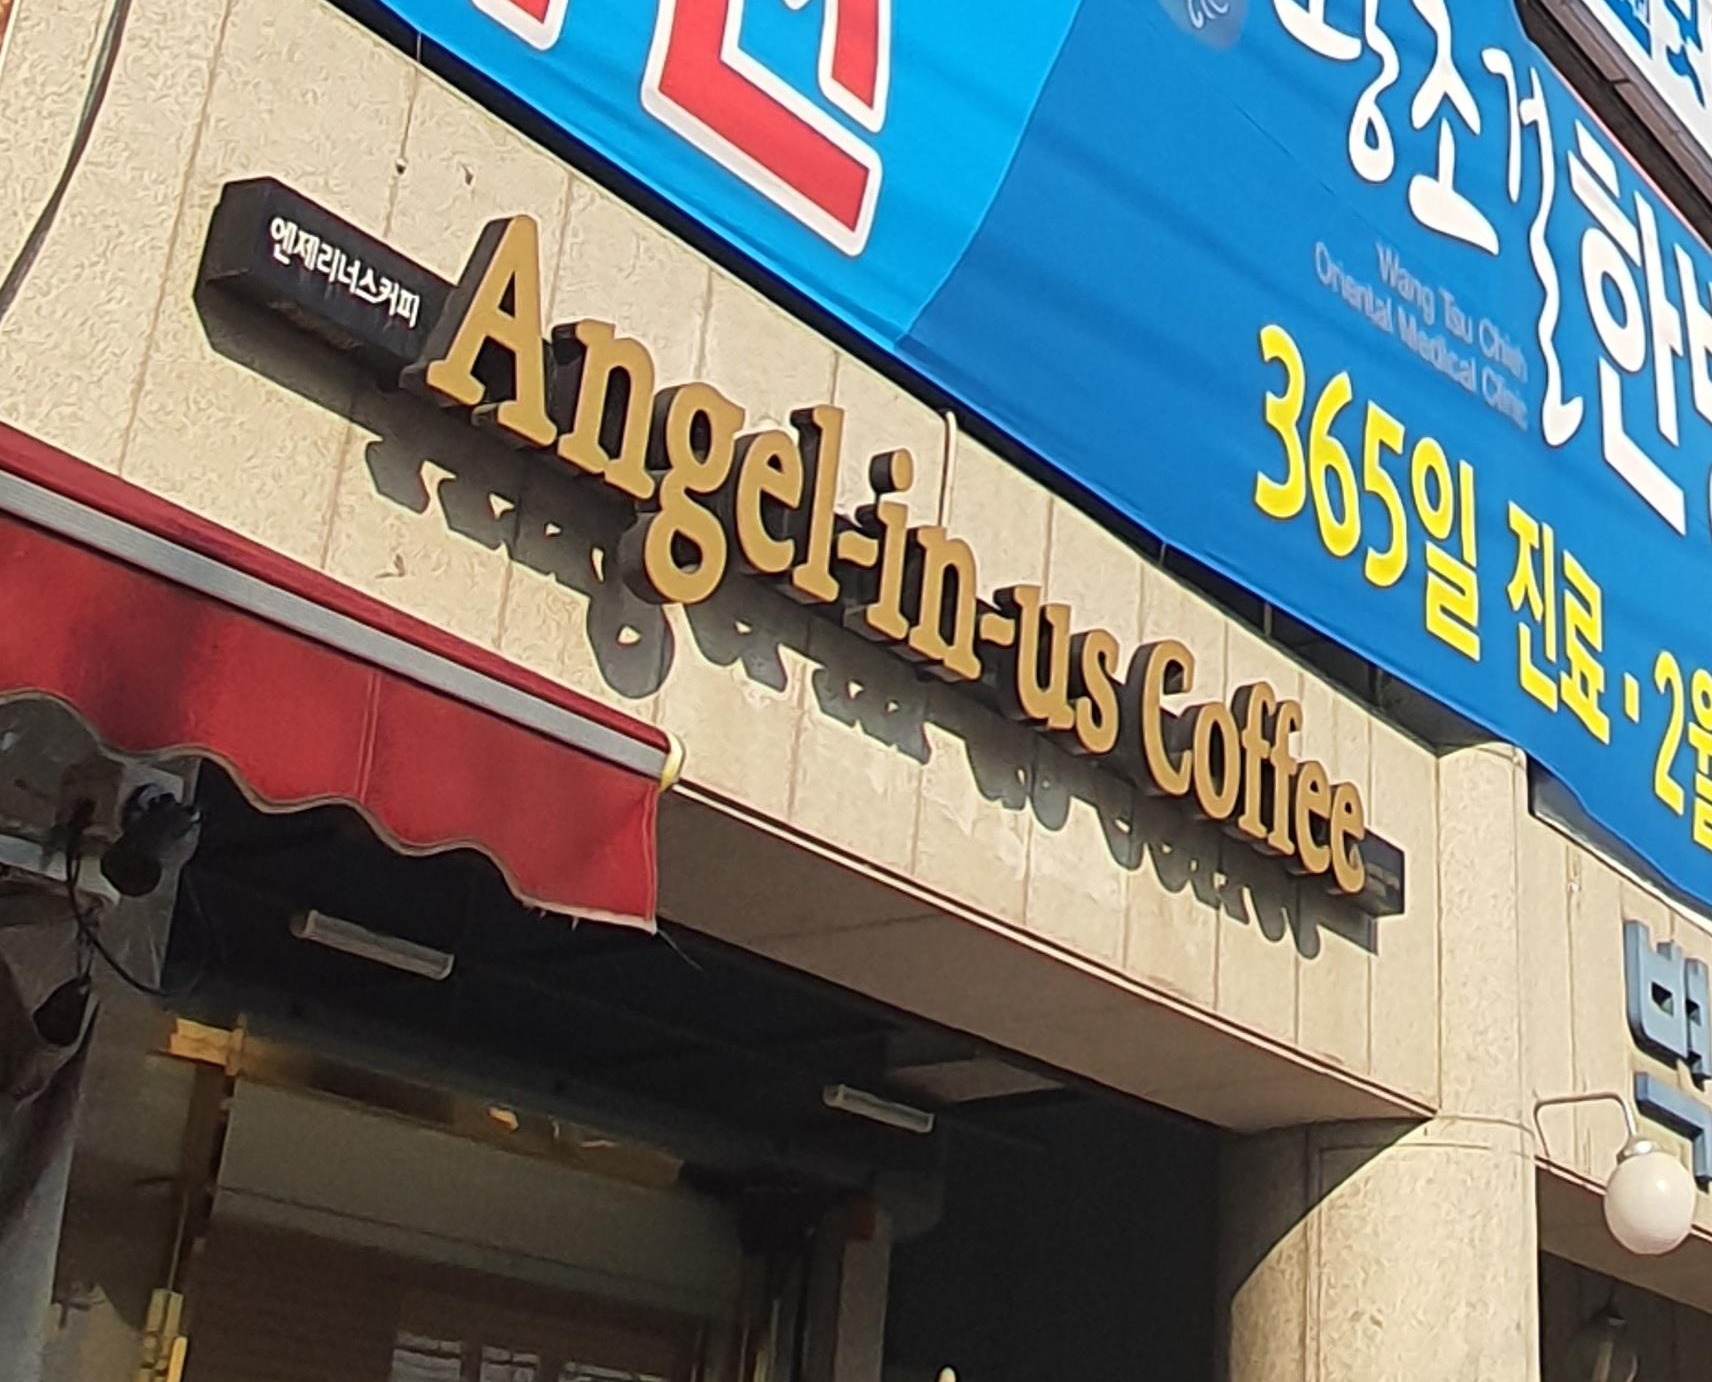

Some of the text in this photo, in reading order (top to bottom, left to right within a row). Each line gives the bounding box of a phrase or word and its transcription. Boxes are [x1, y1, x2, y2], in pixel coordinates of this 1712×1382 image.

[269, 216, 421, 328] 엔제리너스커피
[1315, 241, 1394, 334] Oriental
[1397, 305, 1478, 394] Medical
[1376, 240, 1435, 326] Wang
[1255, 324, 1481, 661] 365일
[1506, 501, 1610, 745] 진료
[1138, 639, 1367, 895] Coffee
